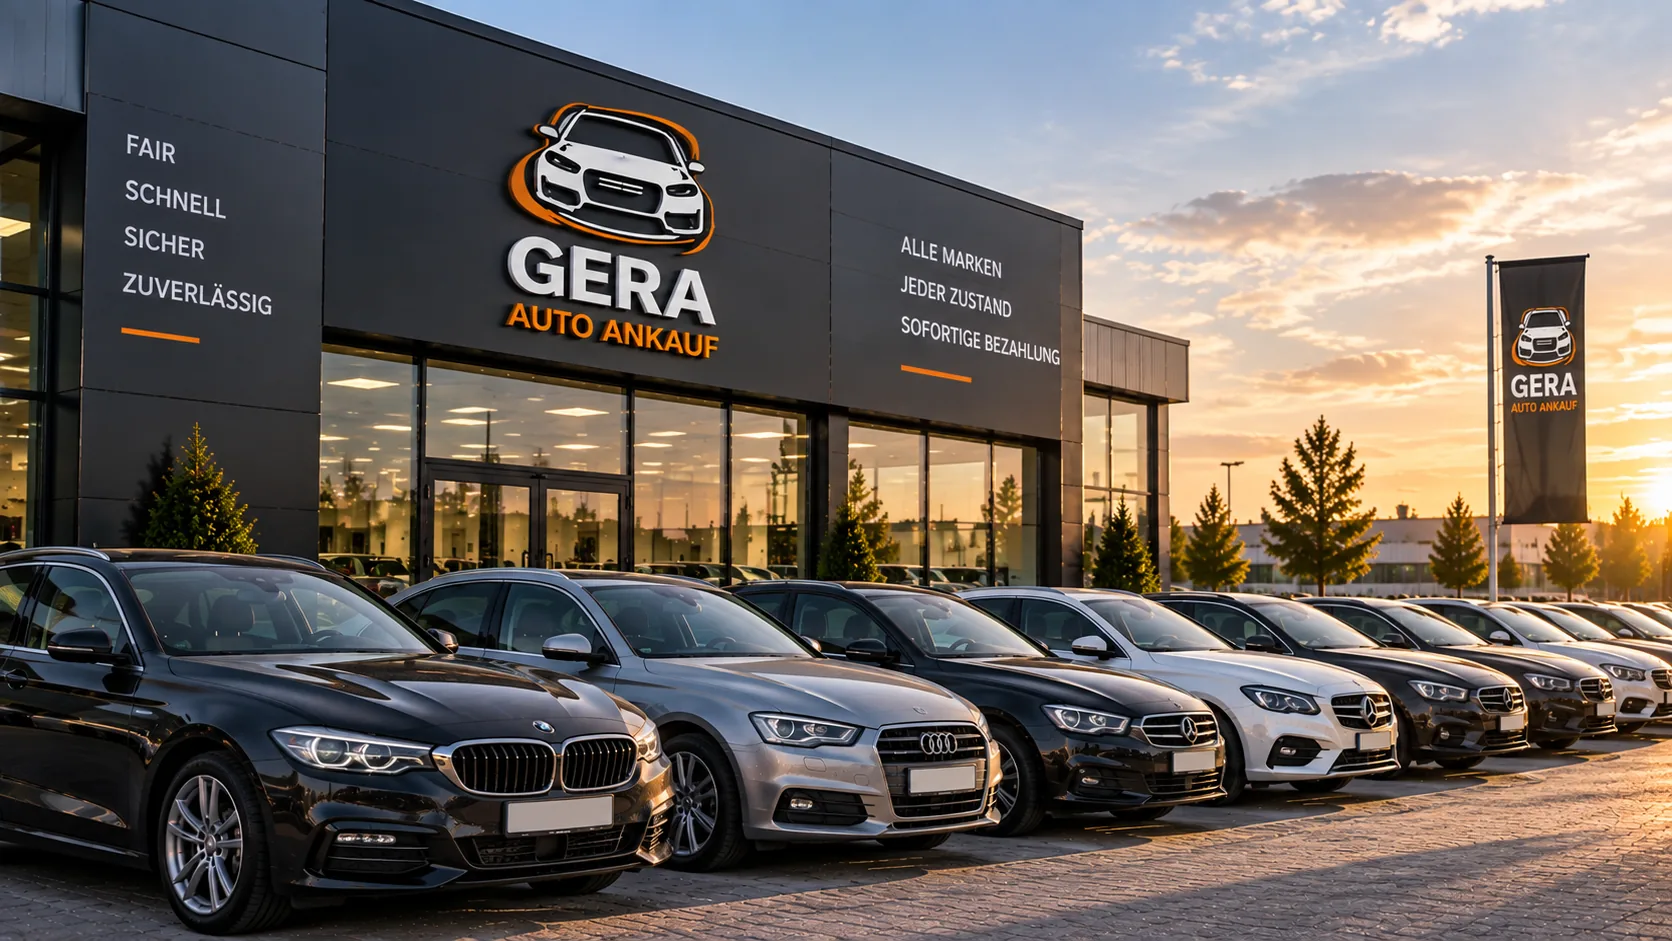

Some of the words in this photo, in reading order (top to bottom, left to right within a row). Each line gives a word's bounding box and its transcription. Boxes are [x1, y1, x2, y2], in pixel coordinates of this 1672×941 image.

[126, 133, 176, 164] FAIR
[125, 179, 227, 219] SCHNELL
[124, 225, 205, 260] SICHER
[901, 236, 938, 262] ALLE
[942, 246, 1002, 278] MARKEN
[122, 272, 272, 315] ZUVERLÄSSIG
[507, 236, 716, 326] GERA
[900, 275, 946, 302] JEDER
[949, 287, 1012, 318] ZUSTAND
[505, 302, 594, 339] AUTO
[601, 319, 719, 358] ANKAUF
[901, 315, 981, 349] SOFORTIGE
[985, 334, 1060, 365] BEZAHLUNG
[1510, 372, 1577, 398] GERA
[1511, 402, 1537, 413] AUTO
[1539, 400, 1577, 412] ANKAUF
